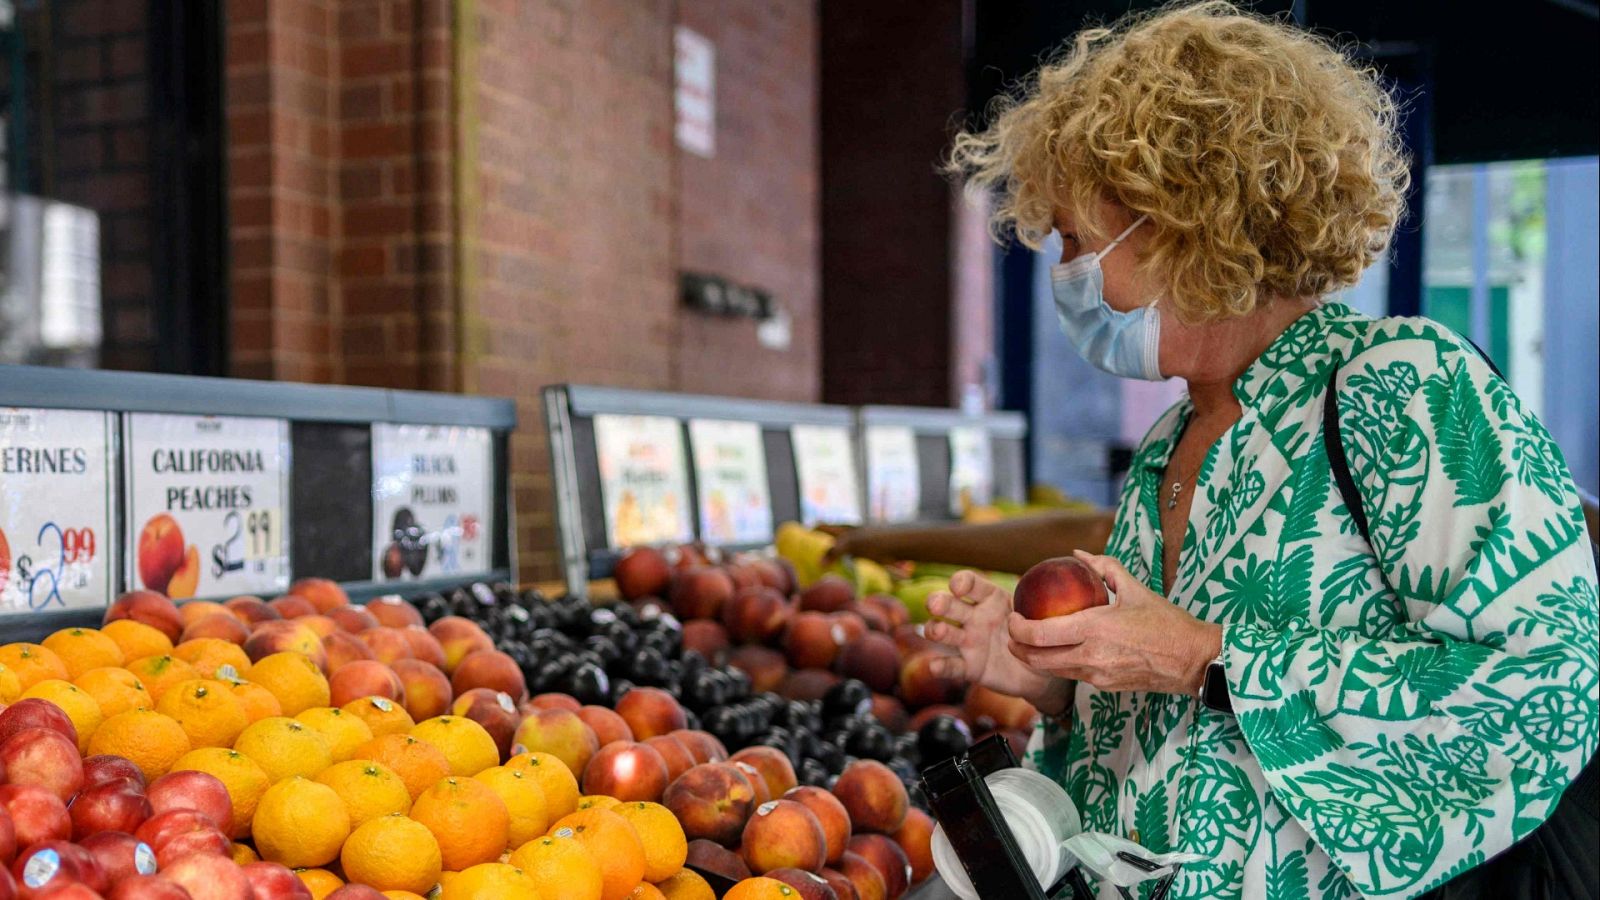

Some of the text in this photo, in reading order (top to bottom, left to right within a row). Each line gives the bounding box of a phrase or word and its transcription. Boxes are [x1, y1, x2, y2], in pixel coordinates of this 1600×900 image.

[2, 447, 87, 474] ERINES
[152, 448, 264, 473] CALIFORNIA
[166, 484, 253, 510] PEACHES
